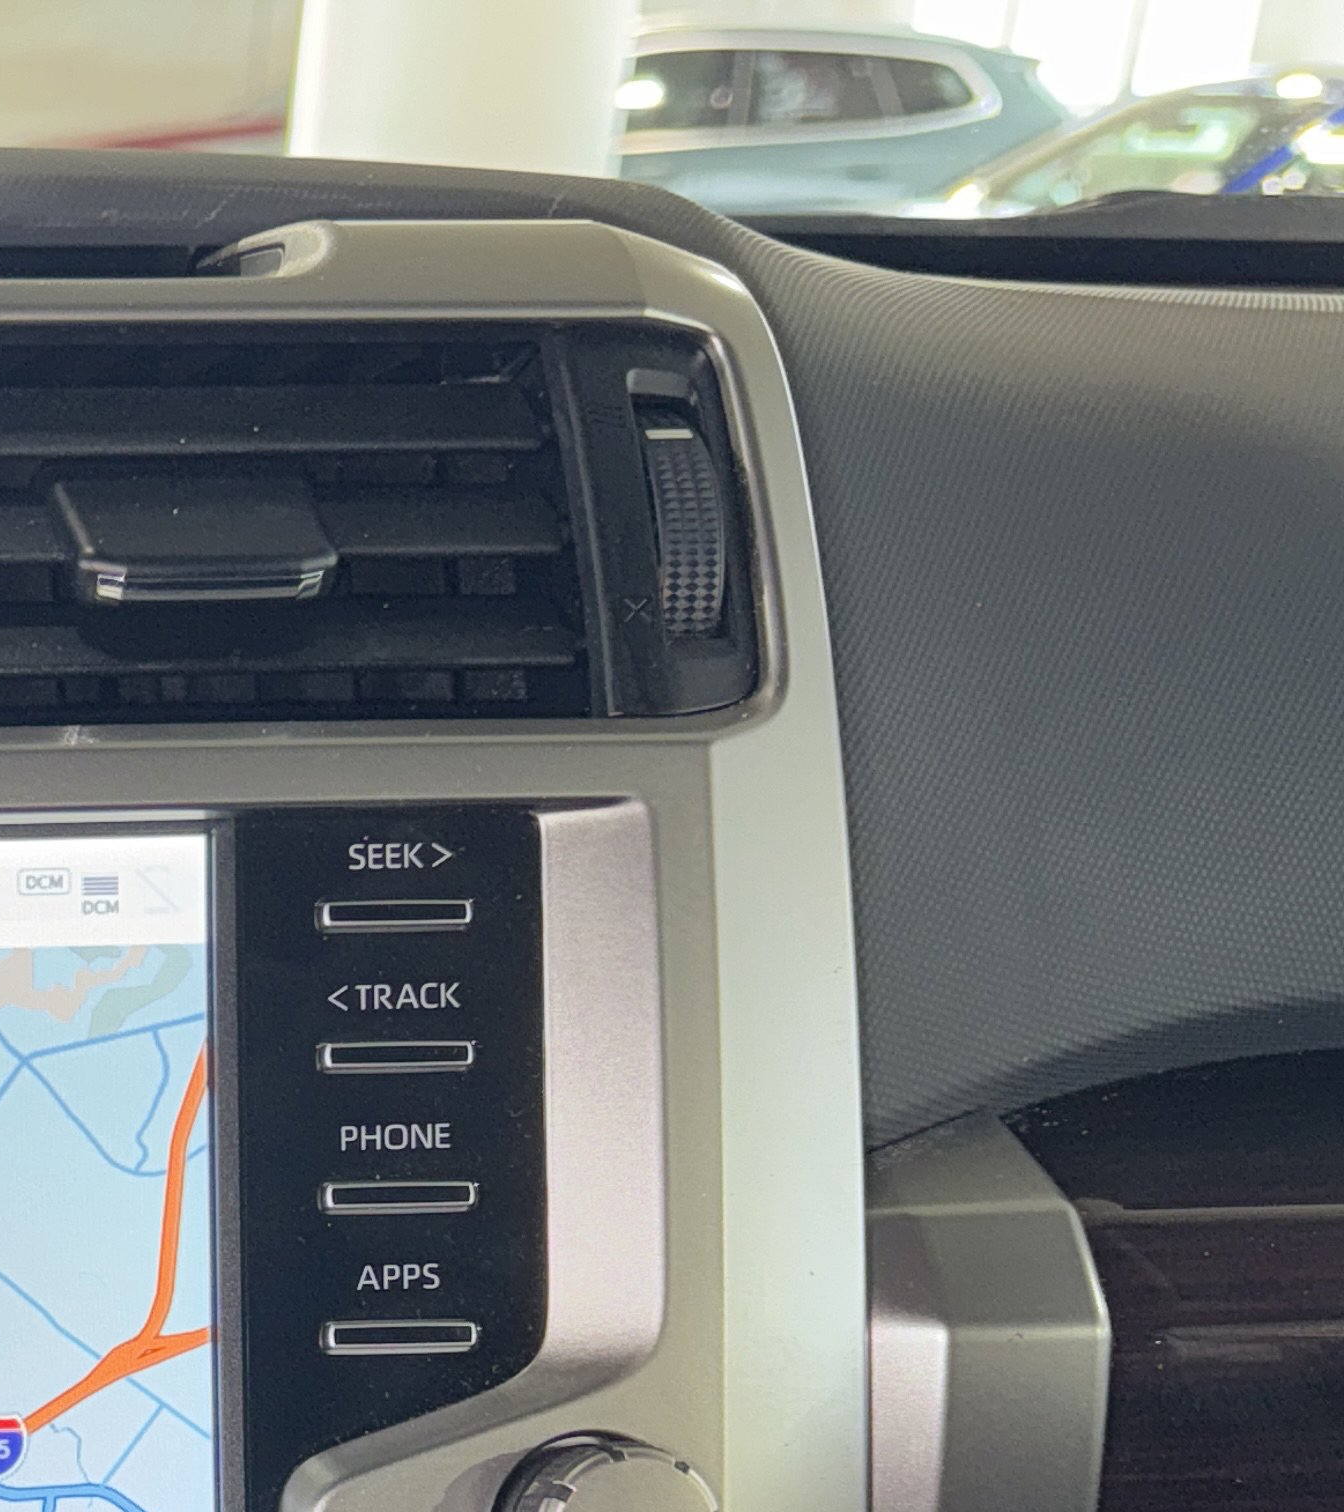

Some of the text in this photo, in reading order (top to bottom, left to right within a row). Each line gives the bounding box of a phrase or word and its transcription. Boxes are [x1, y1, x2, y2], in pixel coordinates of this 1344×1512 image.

[25, 874, 64, 891] DCM
[81, 899, 120, 916] DCM
[339, 1122, 452, 1152] PHONE
[356, 1263, 442, 1291] APPS
